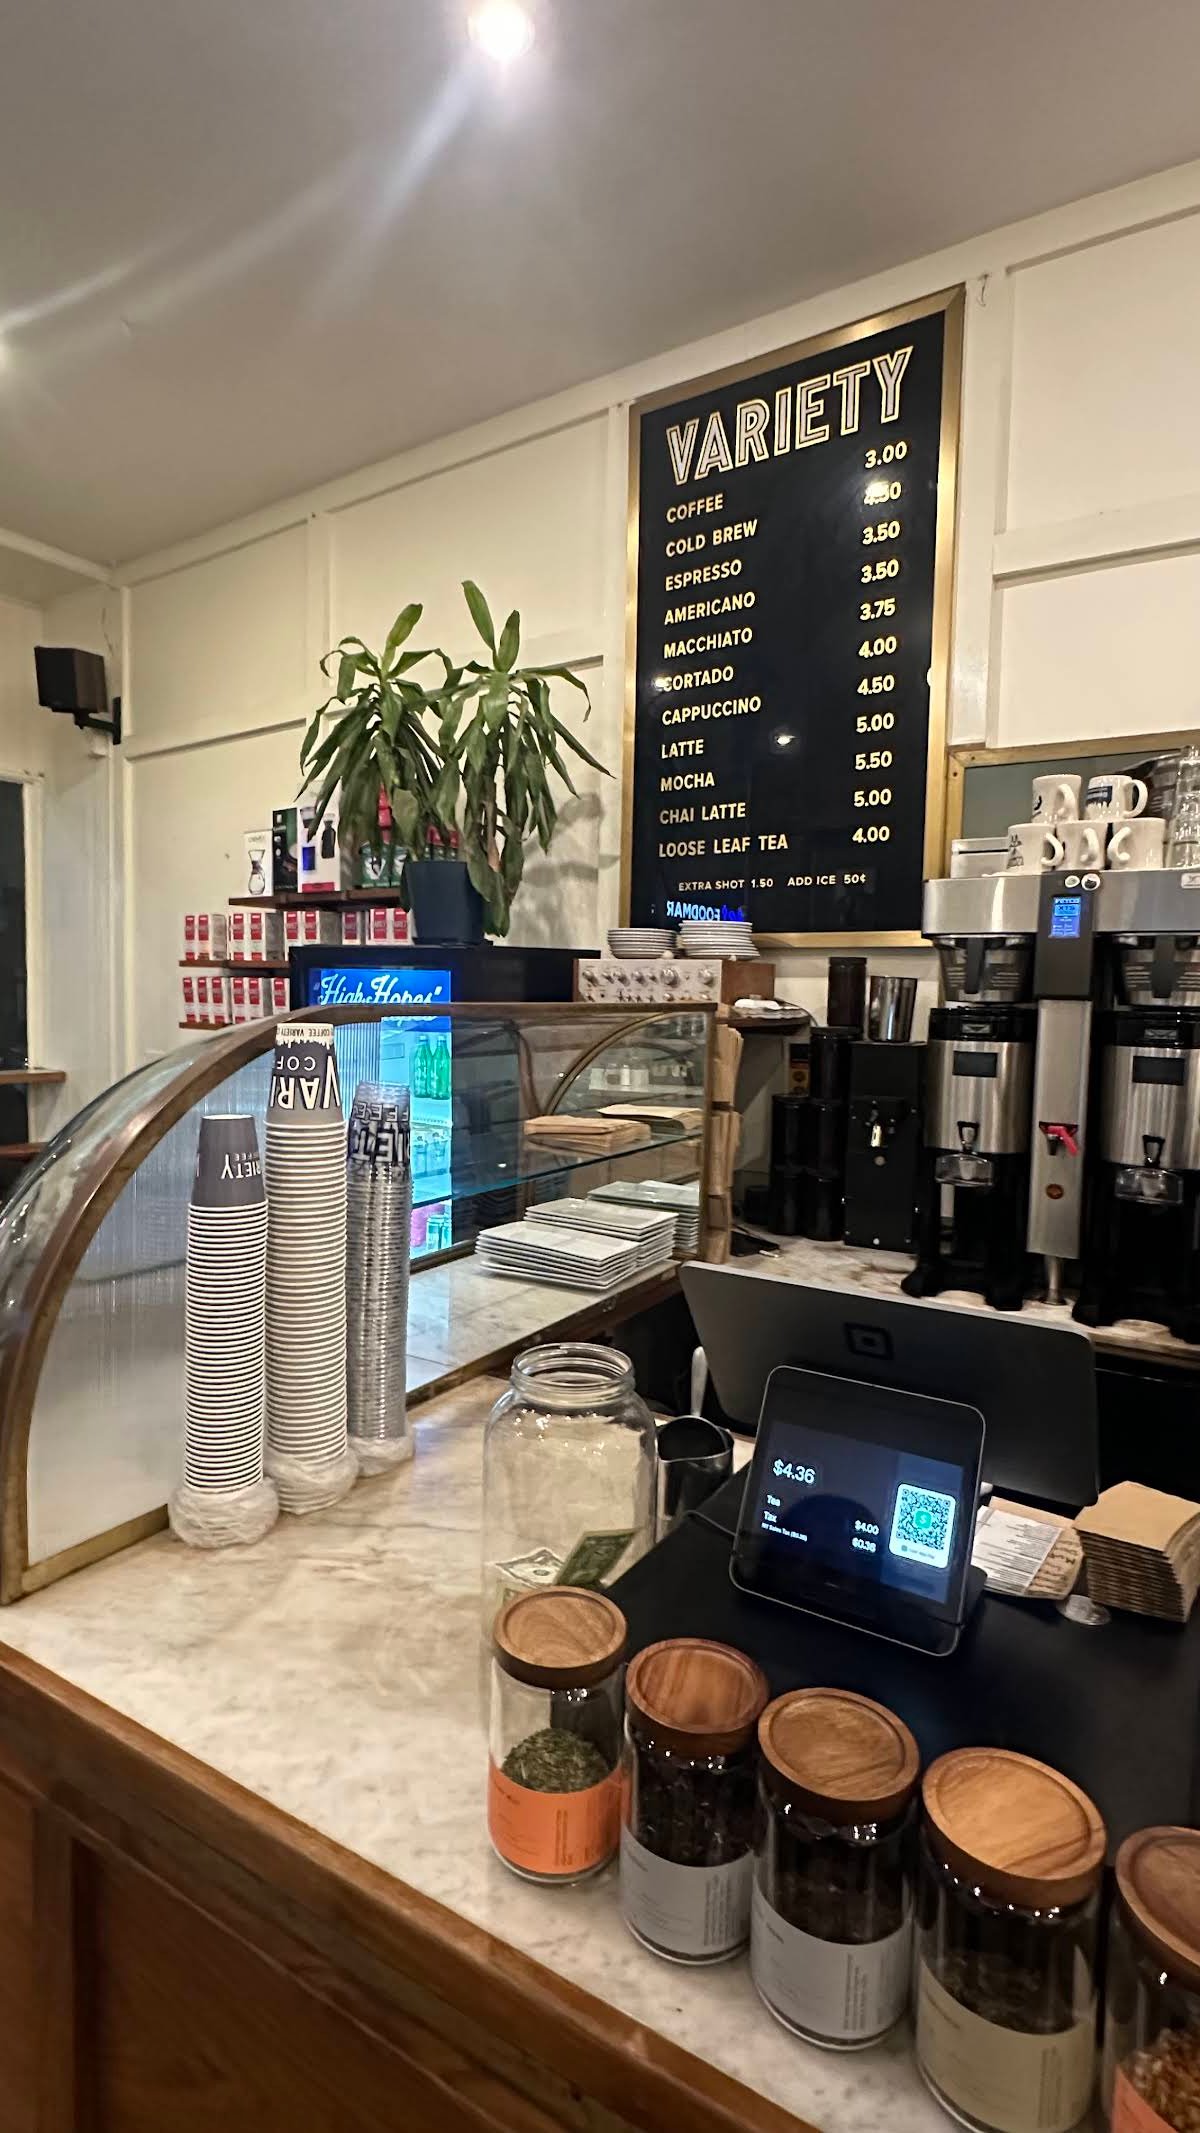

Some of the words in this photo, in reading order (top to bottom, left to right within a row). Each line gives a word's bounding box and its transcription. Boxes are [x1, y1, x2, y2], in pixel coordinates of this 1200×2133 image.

[666, 346, 914, 485] VARIETY
[666, 493, 723, 523] COFFEE
[864, 441, 907, 469] 3.00
[665, 533, 706, 557] COLD
[712, 519, 758, 546] BREW
[665, 559, 742, 591] ESPRESSO
[862, 520, 900, 545] 3.50
[664, 591, 756, 625] AMERICANO
[861, 559, 899, 584] 3.50
[663, 627, 753, 659] MACCHIATO
[859, 598, 895, 621] 3.75
[662, 665, 734, 692] CORTADO
[858, 636, 897, 659] 4.00
[662, 696, 761, 726] CAPPUCCINO
[857, 674, 895, 696] 4.50
[661, 738, 704, 759] LATTE
[856, 712, 895, 734] 5.00
[660, 772, 715, 792] MOCHA
[855, 750, 893, 771] 5.50
[659, 807, 694, 825] CHAI
[701, 802, 746, 822] LATTE
[854, 788, 892, 808] 5.00
[658, 840, 706, 858] LOOSE
[713, 836, 751, 855] LEAF
[758, 834, 789, 851] TEA
[852, 826, 890, 843] 4.00
[678, 881, 712, 892] EXTRA
[715, 879, 745, 890] SHOT
[750, 878, 774, 889] 1.50
[787, 876, 812, 887] ADD
[816, 875, 836, 886] ICE
[843, 873, 866, 885] 50¢
[772, 1458, 816, 1485] $4.36
